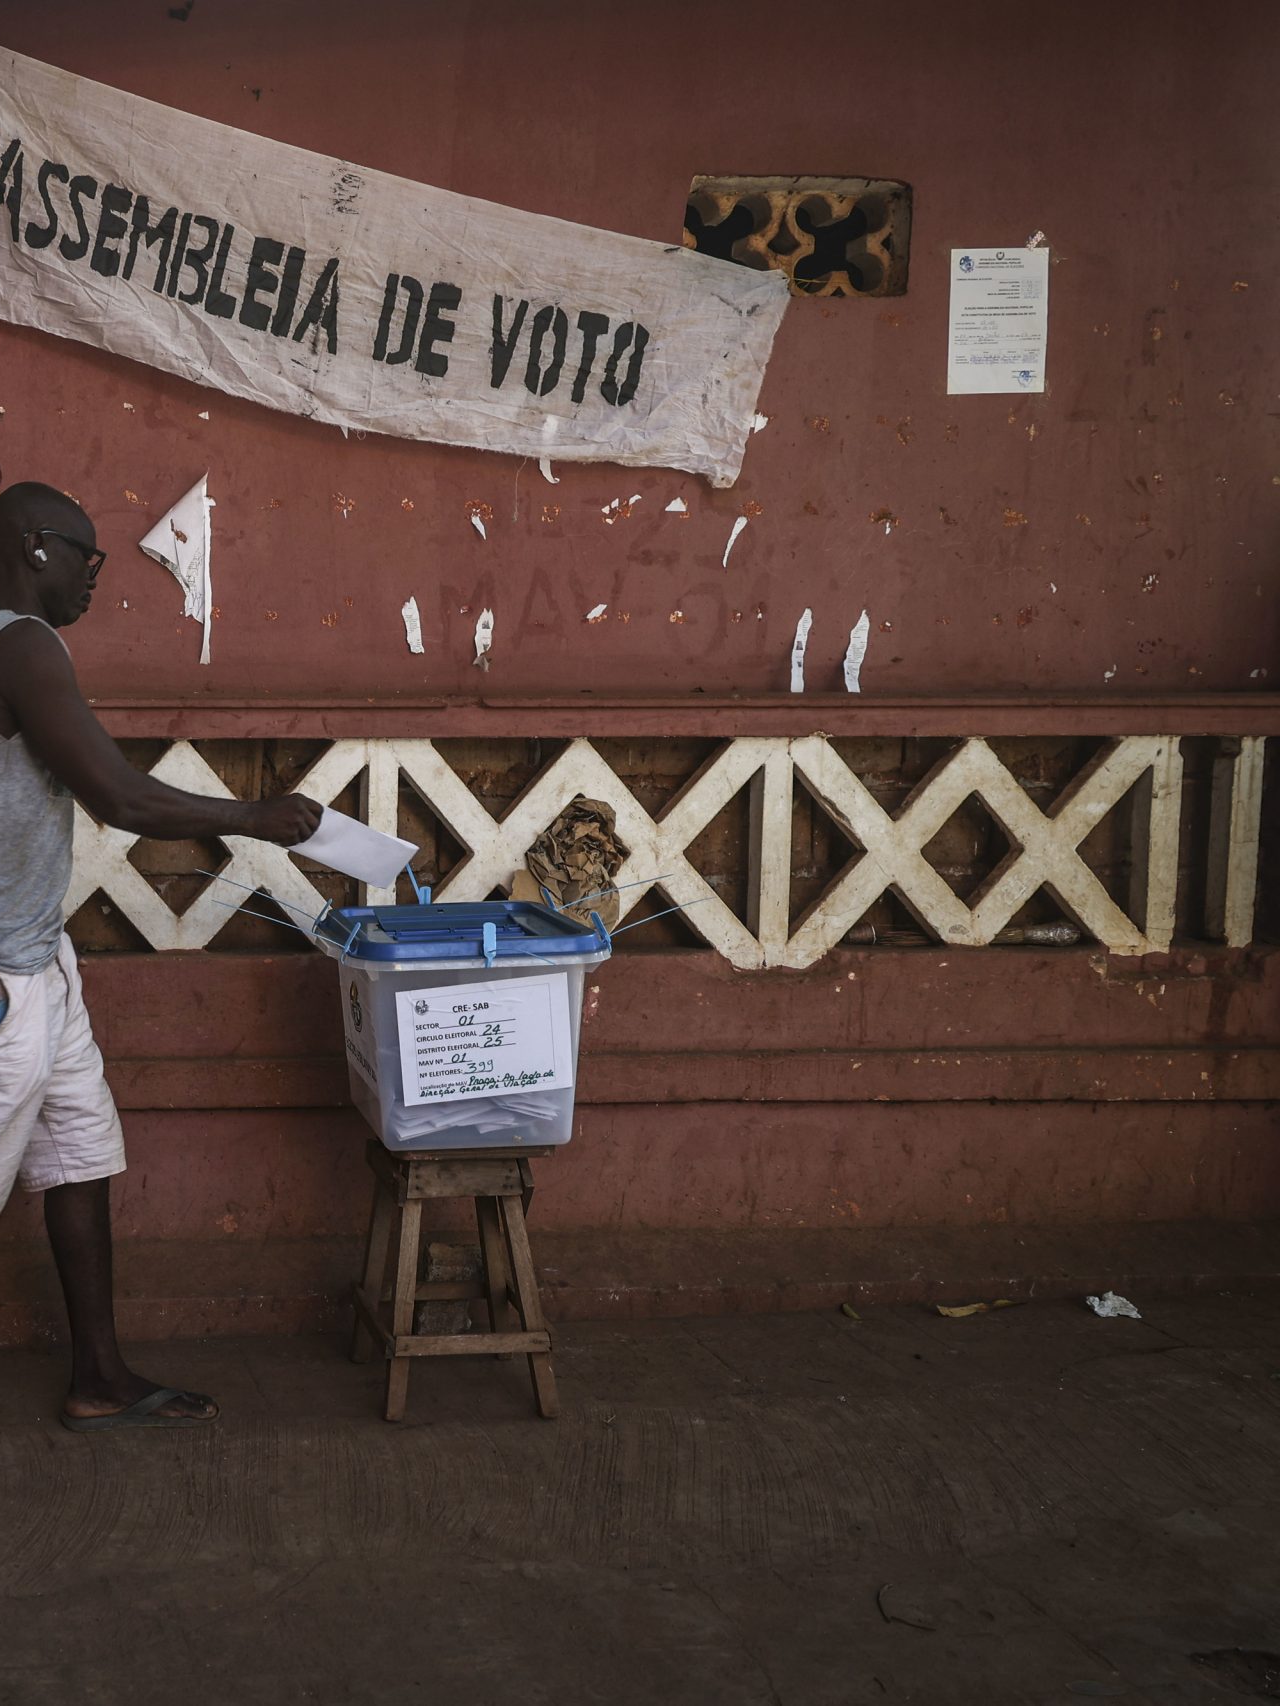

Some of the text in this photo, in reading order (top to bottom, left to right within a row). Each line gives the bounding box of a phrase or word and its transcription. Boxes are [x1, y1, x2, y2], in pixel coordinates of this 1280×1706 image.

[372, 273, 463, 378] DE
[488, 293, 651, 409] VOTO
[472, 1002, 490, 1011] SAB
[415, 1014, 475, 1031] SECTOR 01
[416, 1024, 501, 1043] CIRCULO ELEITORAL 24
[417, 1036, 504, 1055] DISTRITO ELEITORAL 25
[451, 1053, 467, 1064] 01
